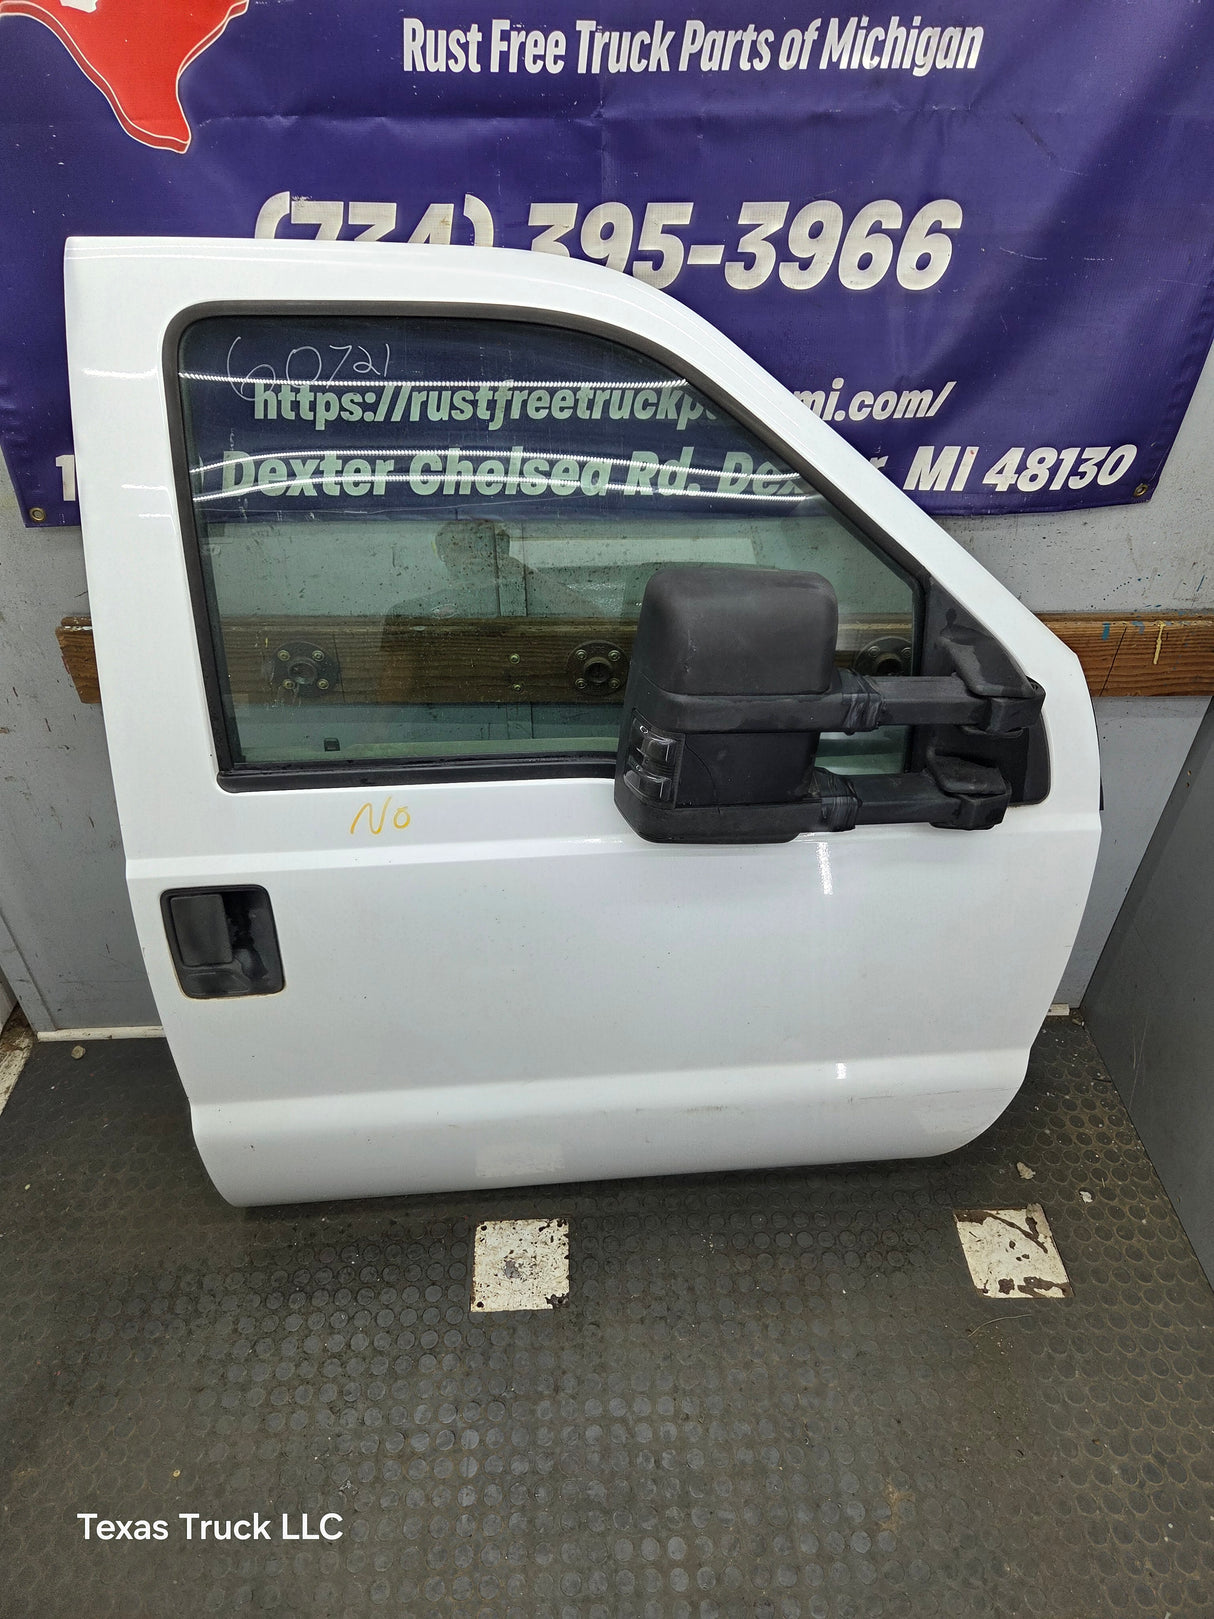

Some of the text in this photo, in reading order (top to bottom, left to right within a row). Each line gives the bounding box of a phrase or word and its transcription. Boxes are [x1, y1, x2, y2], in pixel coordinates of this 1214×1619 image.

[403, 15, 984, 77] Rust Free Truck Parts of Michigan
[527, 199, 963, 290] 395-3966
[226, 336, 390, 401] 60721
[222, 450, 395, 497] Dexter
[409, 446, 612, 496] Chelsea
[623, 446, 701, 497] Rd.
[903, 445, 979, 492] MI
[982, 444, 1138, 492] 48130
